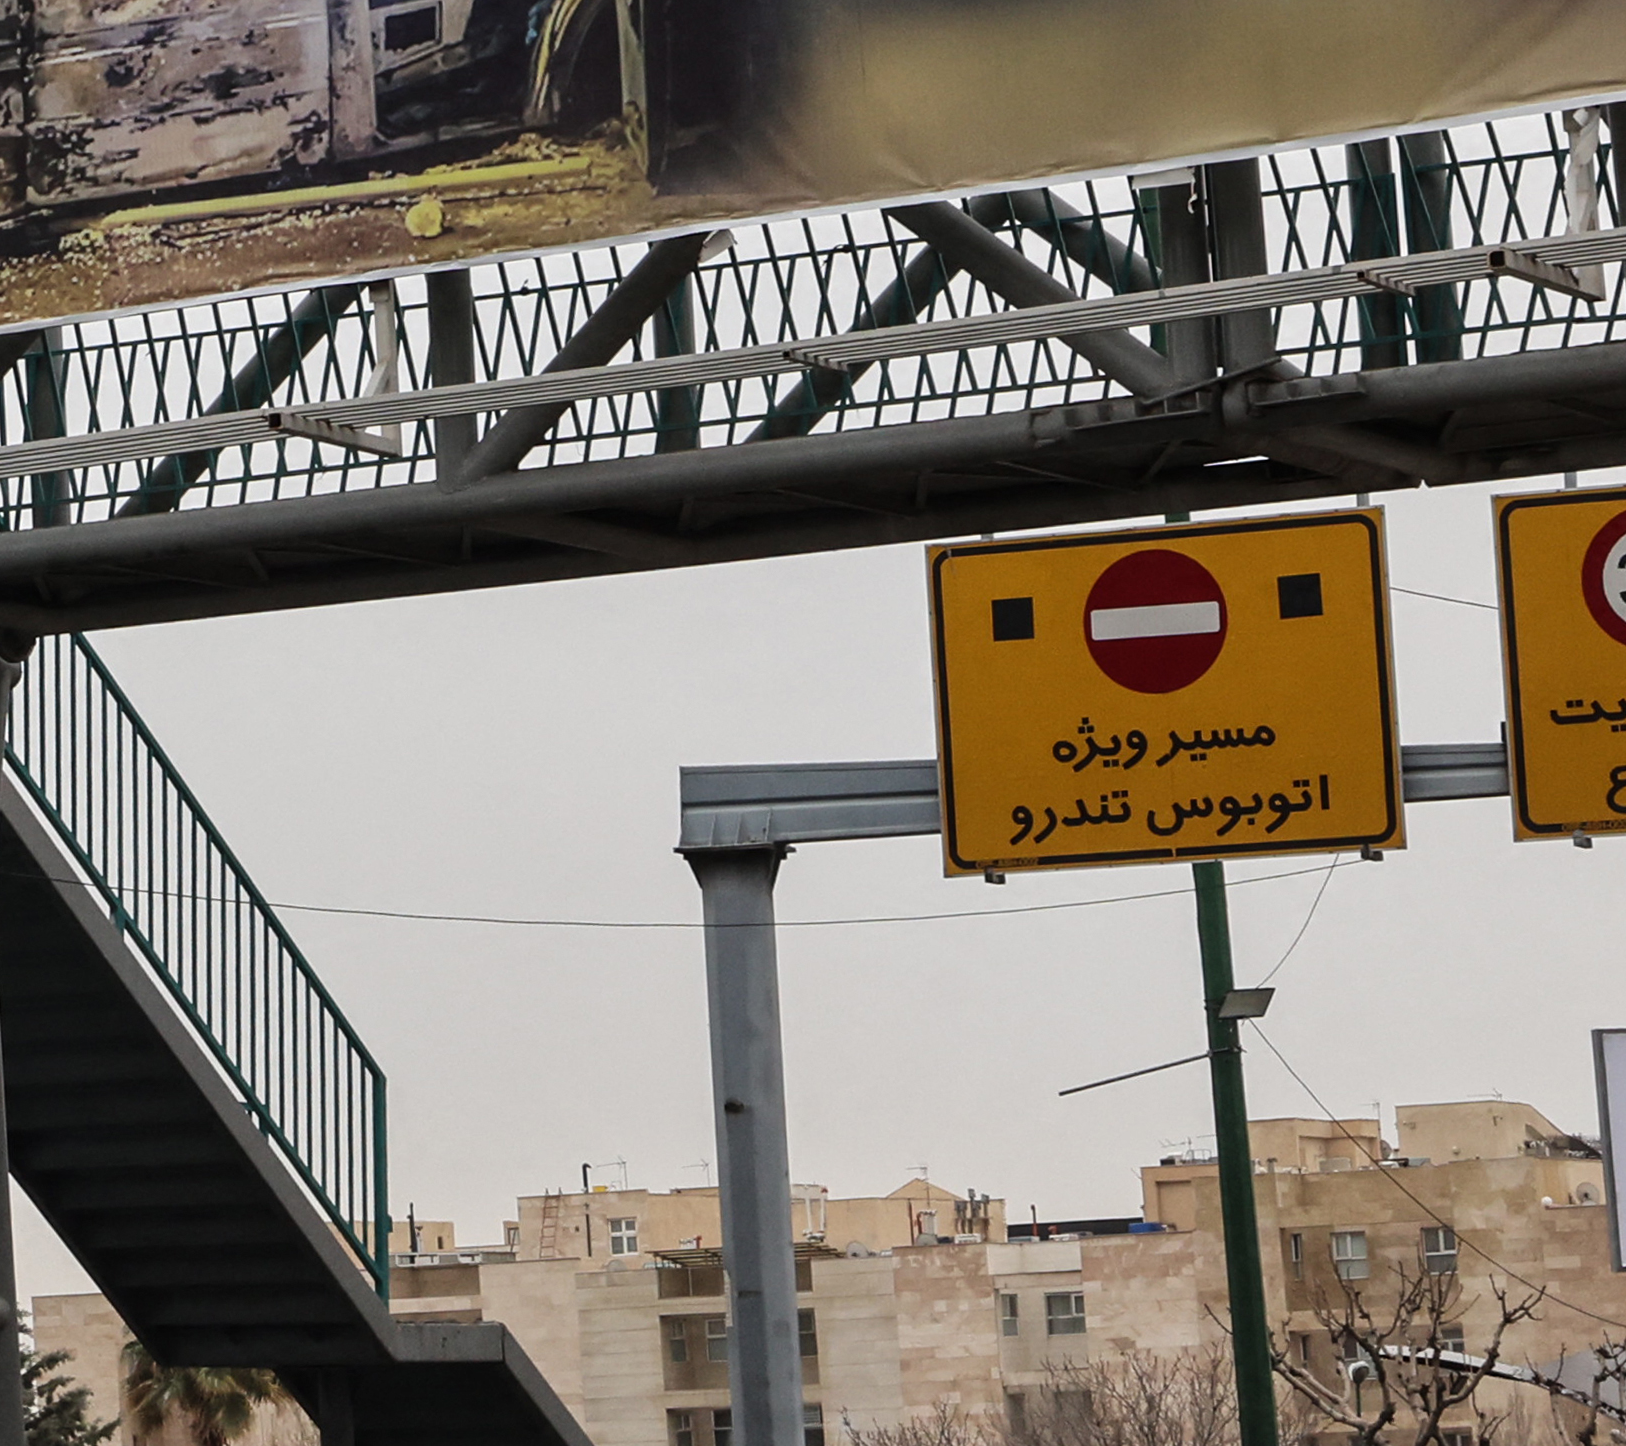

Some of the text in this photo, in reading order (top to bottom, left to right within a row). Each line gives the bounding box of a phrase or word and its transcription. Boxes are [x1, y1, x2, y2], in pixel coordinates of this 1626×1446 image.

[1052, 717, 1276, 772] مسیر ویژه
[1010, 774, 1331, 845] اتوبوس تندرو
